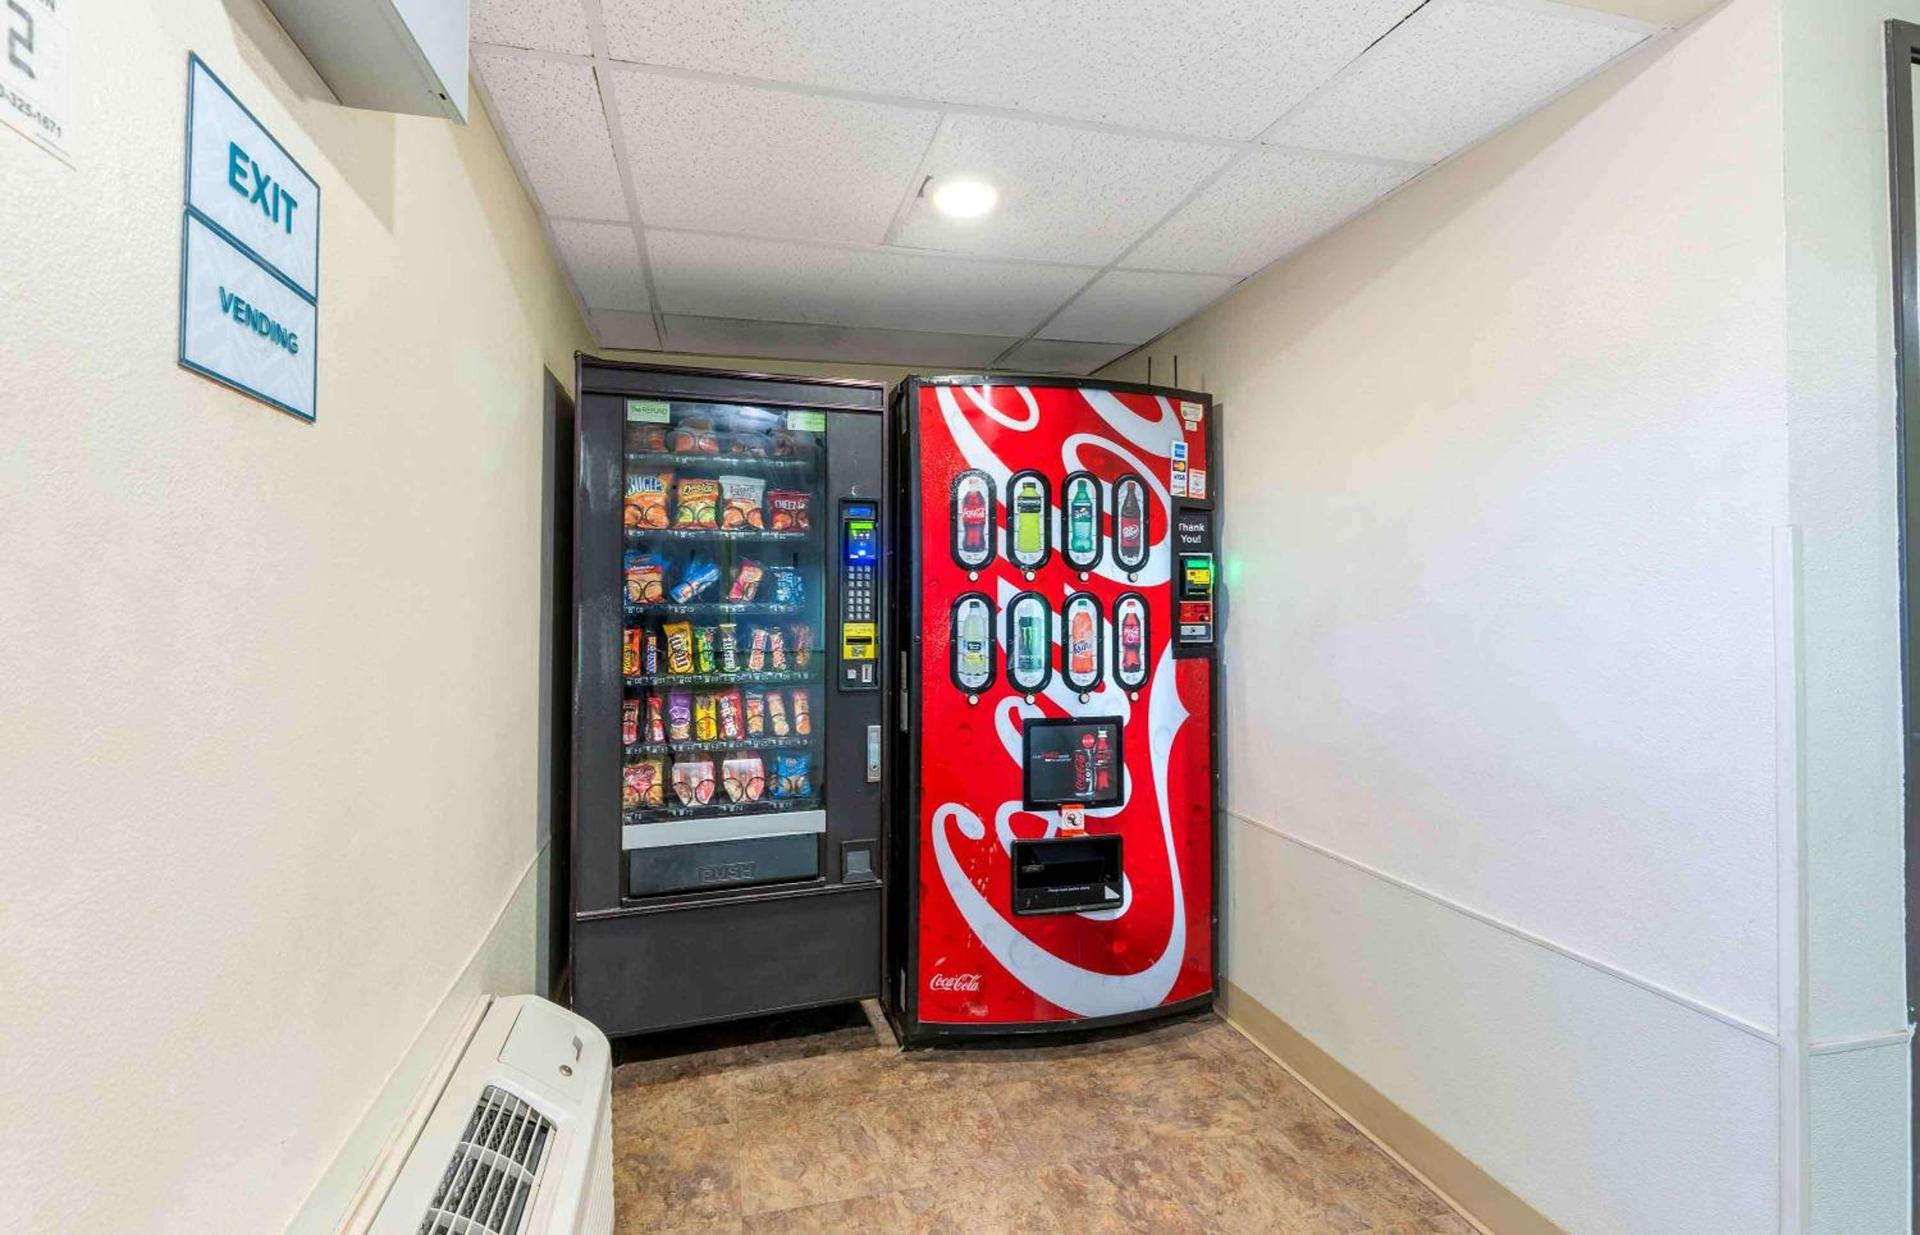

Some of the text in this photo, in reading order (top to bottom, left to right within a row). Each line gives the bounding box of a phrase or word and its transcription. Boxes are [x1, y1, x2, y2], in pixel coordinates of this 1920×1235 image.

[228, 141, 298, 234] EXIT
[219, 286, 299, 355] VENDING
[1179, 523, 1205, 532] Thank
[1181, 535, 1202, 544] You!
[929, 973, 982, 992] Coca-Cola
